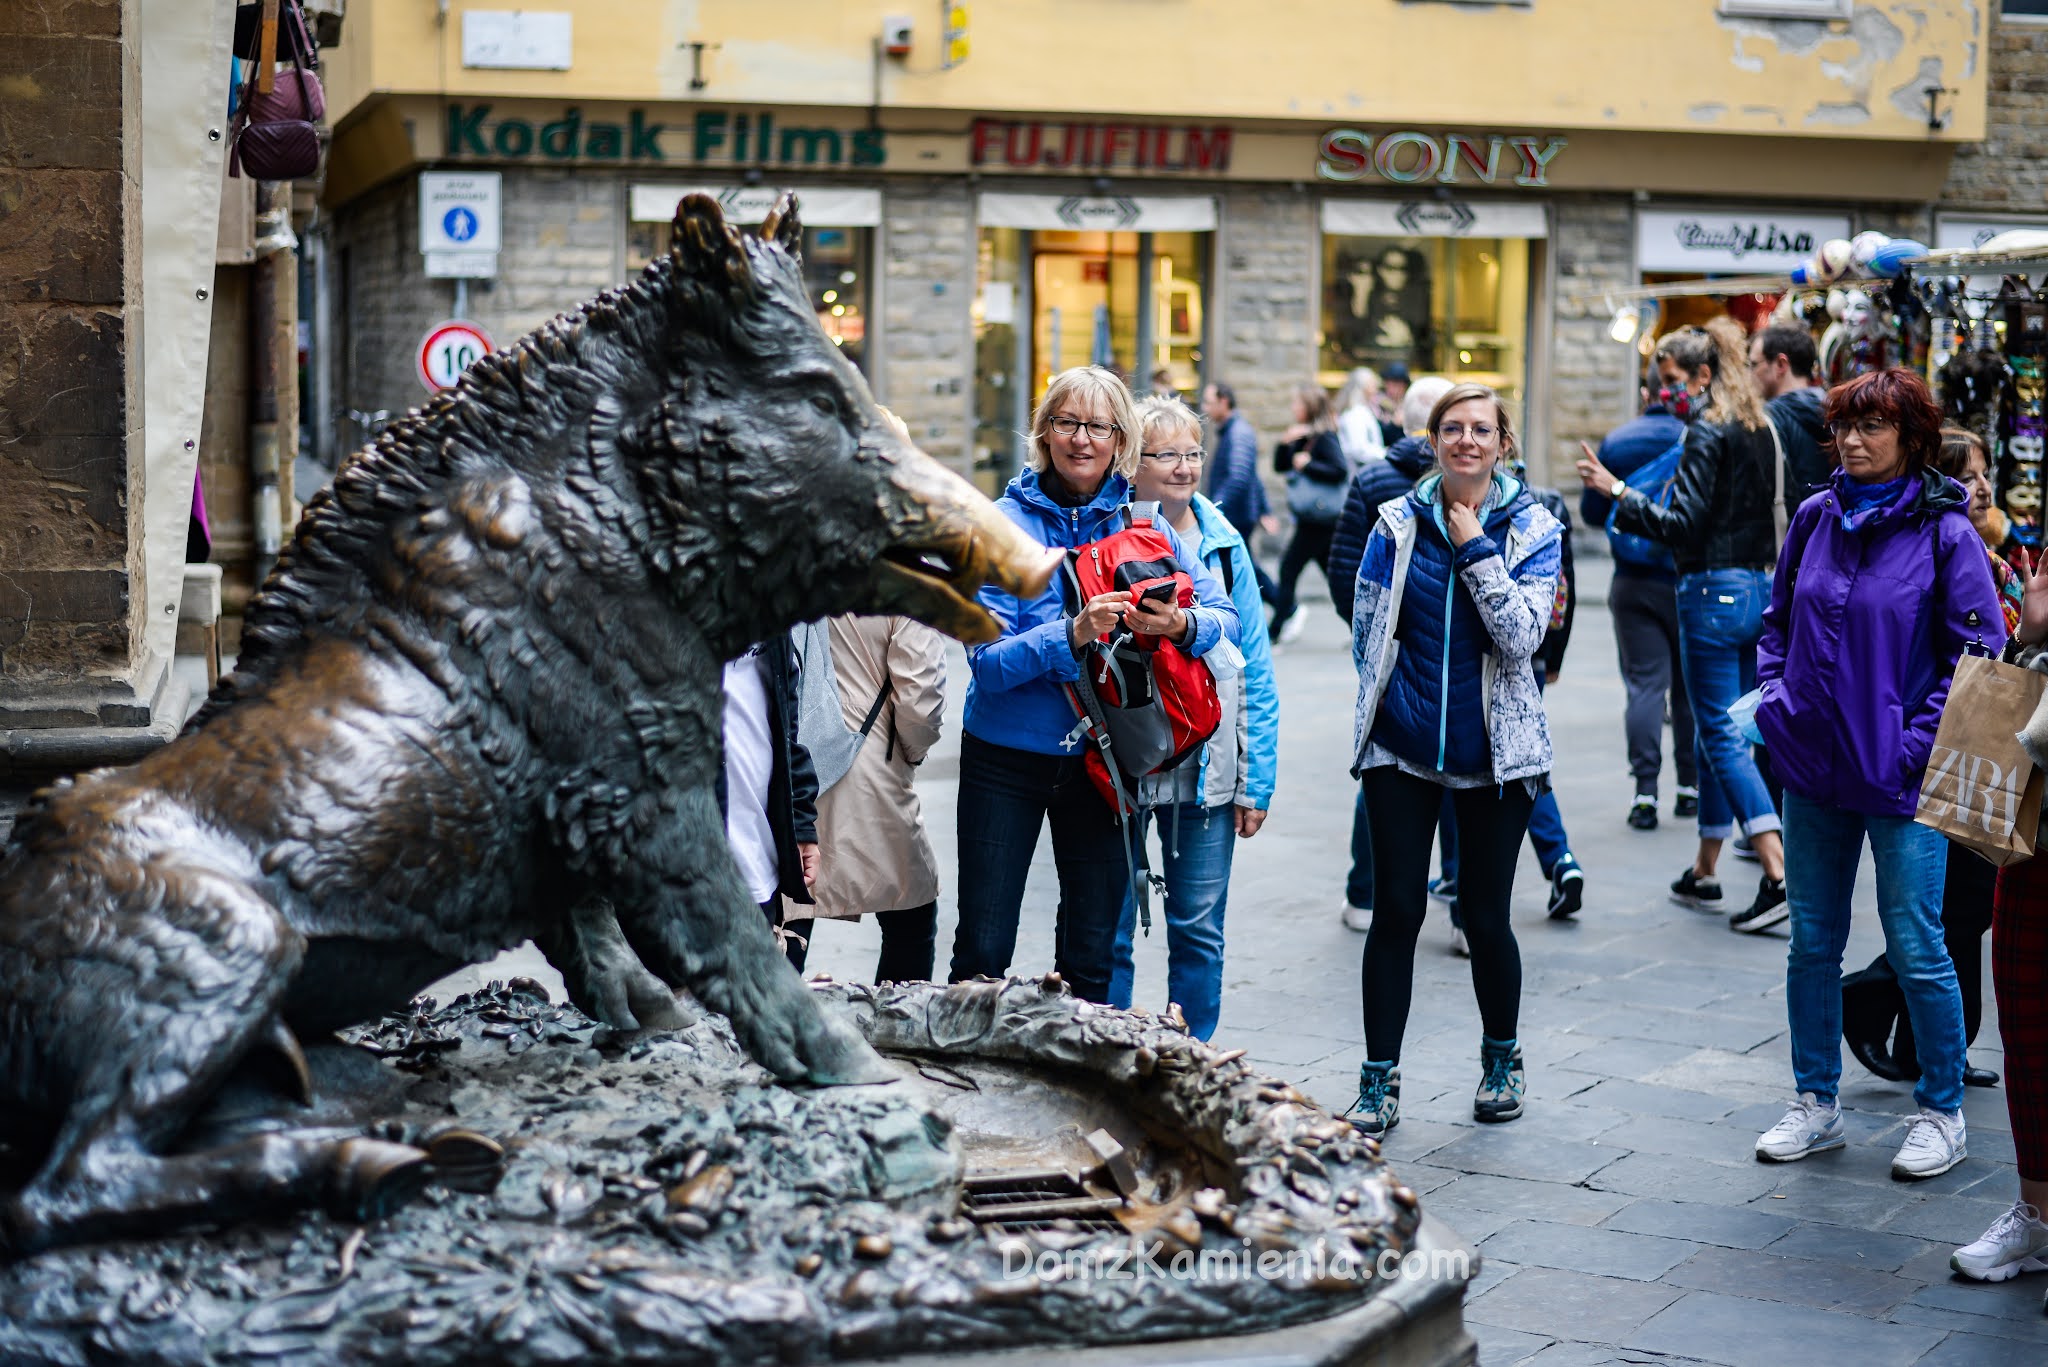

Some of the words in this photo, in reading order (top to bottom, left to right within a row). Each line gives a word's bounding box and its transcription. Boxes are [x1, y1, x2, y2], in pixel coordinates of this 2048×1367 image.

[447, 103, 665, 159] Kodak
[694, 111, 888, 166] Films
[971, 118, 1233, 172] FUJIFILM
[1316, 128, 1568, 187] SONY
[444, 345, 474, 377] 10
[1917, 744, 2017, 838] ZARA
